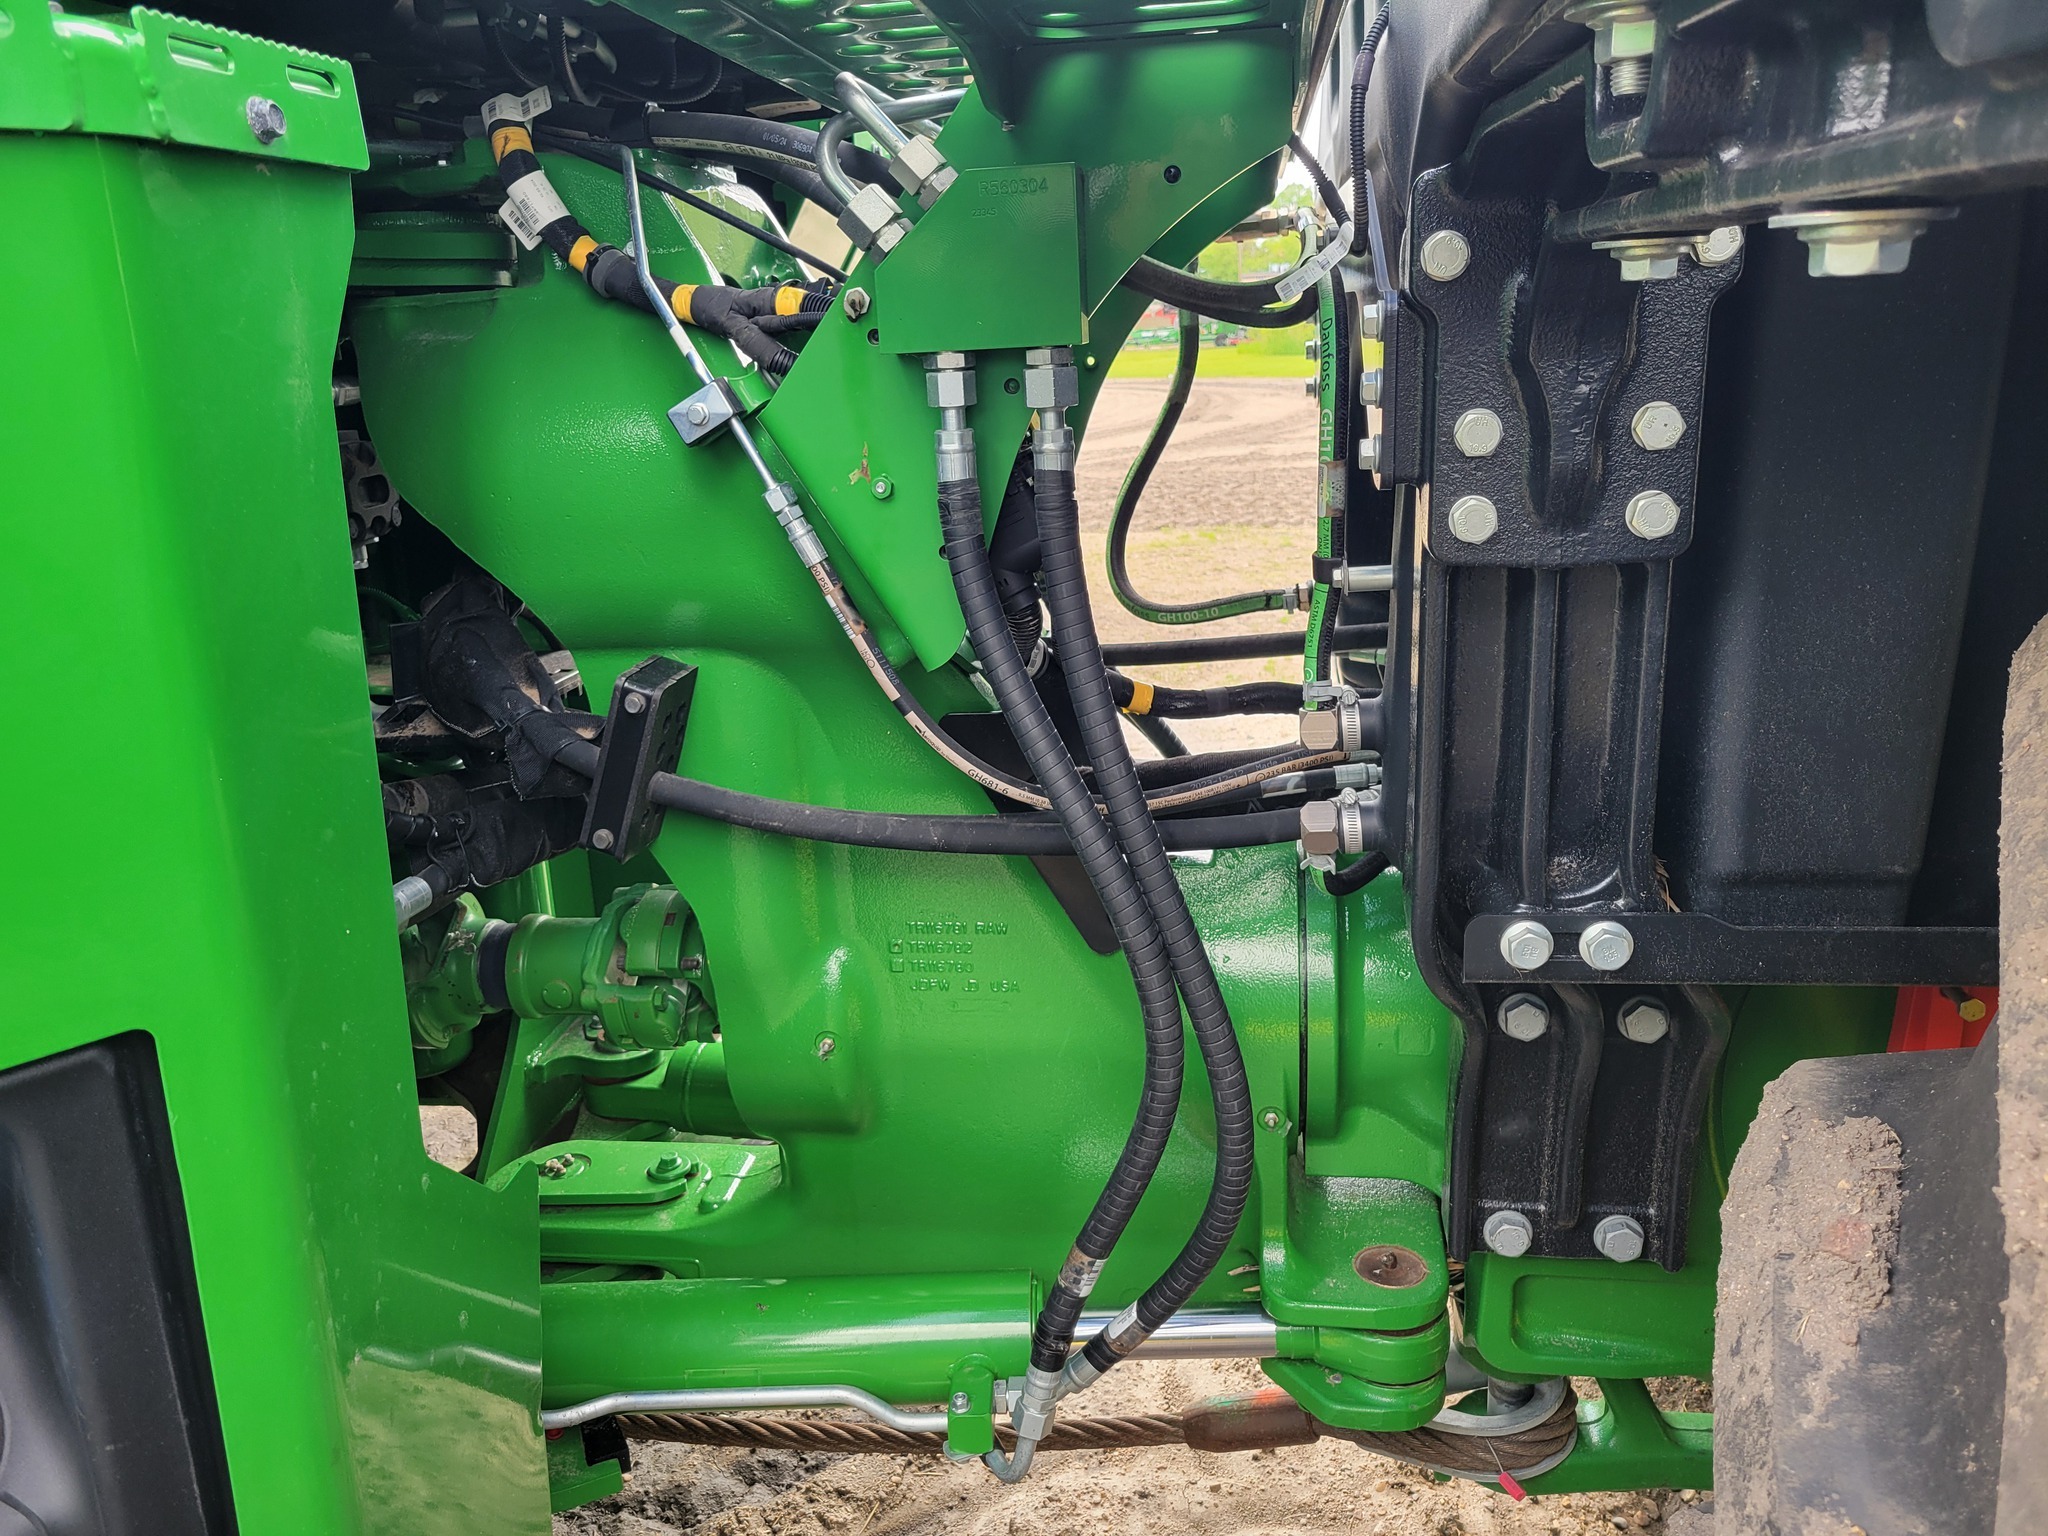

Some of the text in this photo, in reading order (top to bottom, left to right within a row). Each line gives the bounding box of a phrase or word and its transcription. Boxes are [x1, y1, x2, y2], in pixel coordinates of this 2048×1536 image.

[979, 177, 1049, 197] R560304
[1445, 236, 1465, 251] 10.9
[1320, 317, 1335, 393] Danfoss
[1469, 443, 1488, 453] 10.9
[1660, 500, 1677, 520] 10.9
[818, 576, 831, 594] PSI)
[1157, 607, 1220, 623] GH100-10
[1312, 599, 1321, 620] ASTM
[1281, 763, 1298, 774] BAR
[967, 768, 1010, 796] GH681-6
[1189, 769, 1244, 789] 2023-12-12
[974, 921, 1009, 935] RAW
[990, 980, 1021, 993] USA
